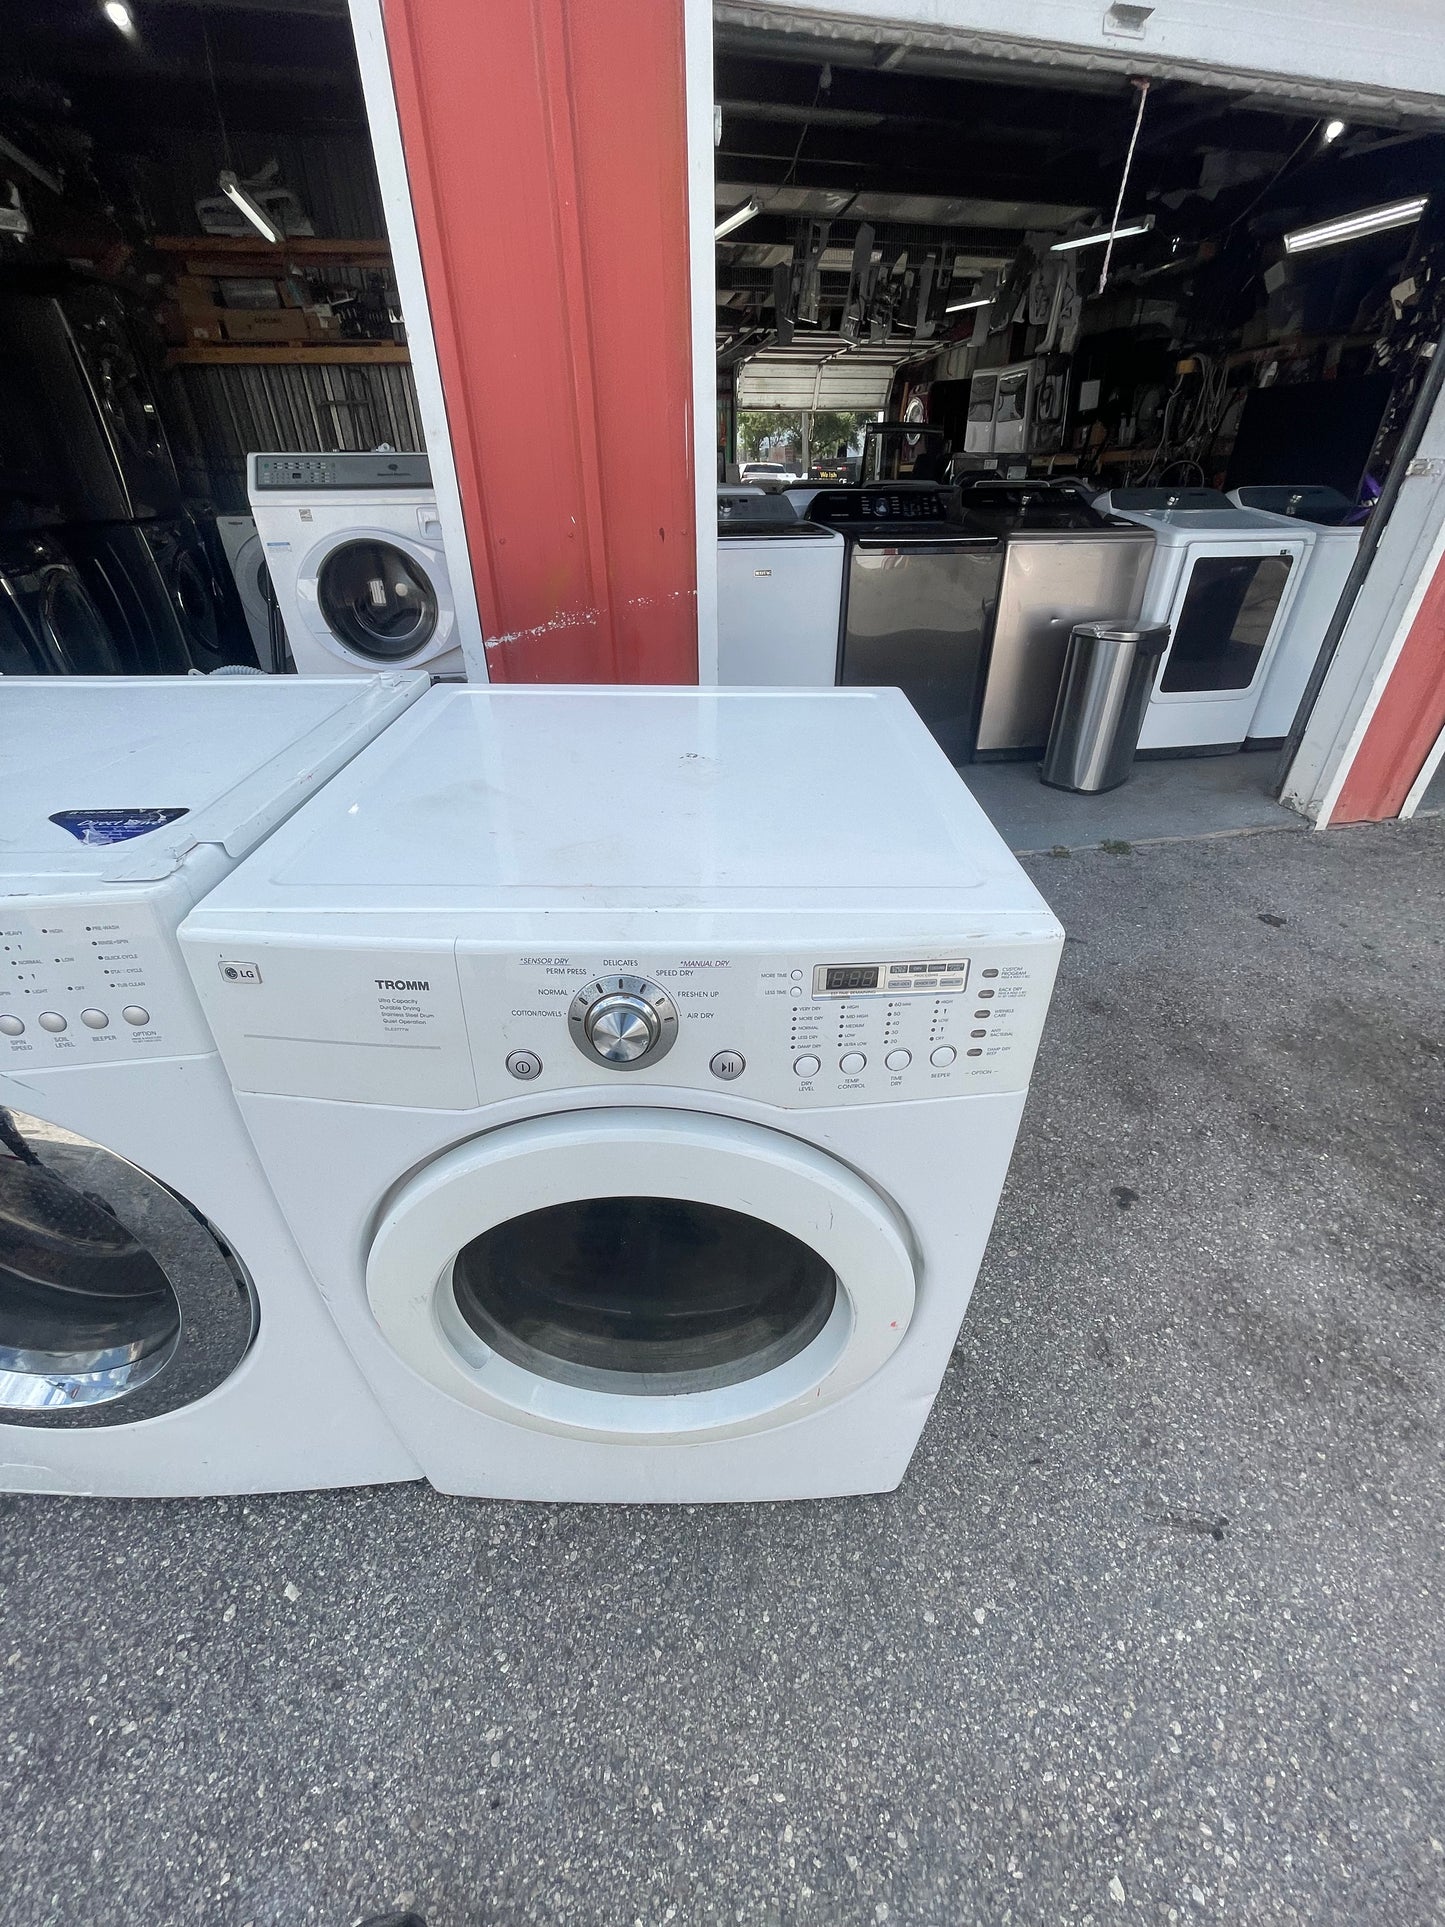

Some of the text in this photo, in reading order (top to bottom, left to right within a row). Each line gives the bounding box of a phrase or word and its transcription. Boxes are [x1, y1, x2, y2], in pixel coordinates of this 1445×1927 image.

[554, 957, 570, 965] DRY
[240, 970, 255, 979] LG
[566, 968, 587, 976] PRESS
[374, 979, 430, 991] TROMM
[677, 991, 709, 999] FRESHEN
